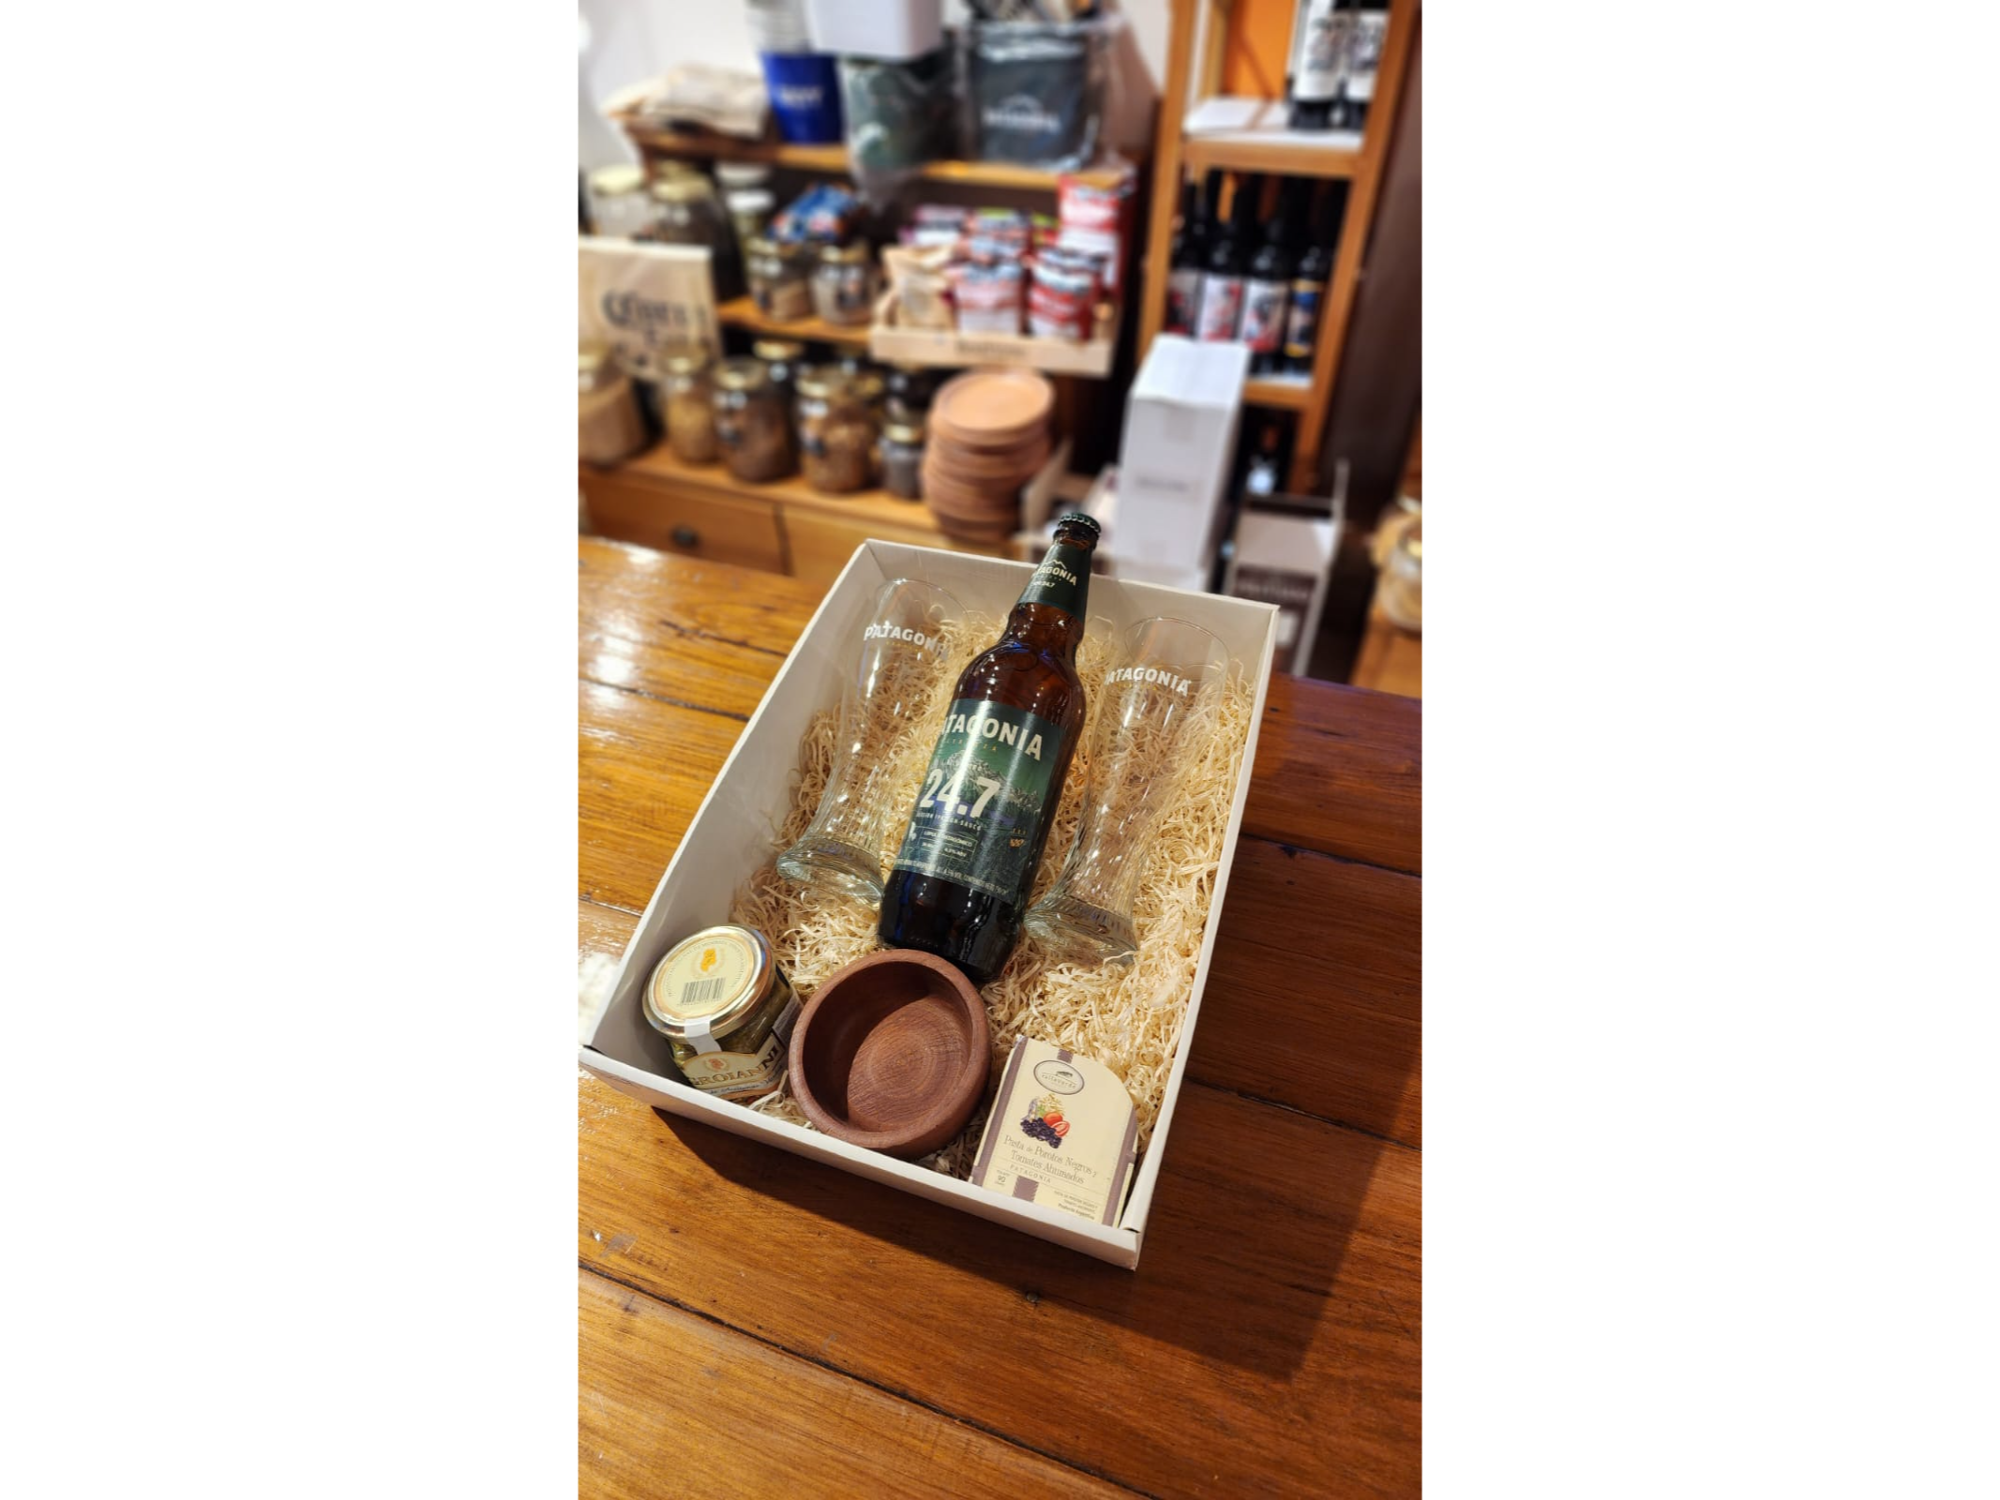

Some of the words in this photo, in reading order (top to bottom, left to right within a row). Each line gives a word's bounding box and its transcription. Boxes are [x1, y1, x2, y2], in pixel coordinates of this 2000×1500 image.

[919, 768, 1001, 818] 24.7
[1003, 1134, 1025, 1150] Pasta
[1035, 1146, 1063, 1164] Porotos
[1065, 1157, 1093, 1175] Negros
[1010, 1164, 1051, 1183] PATAGONIA
[1011, 1150, 1042, 1168] Tomates
[1043, 1162, 1085, 1185] Ahumados
